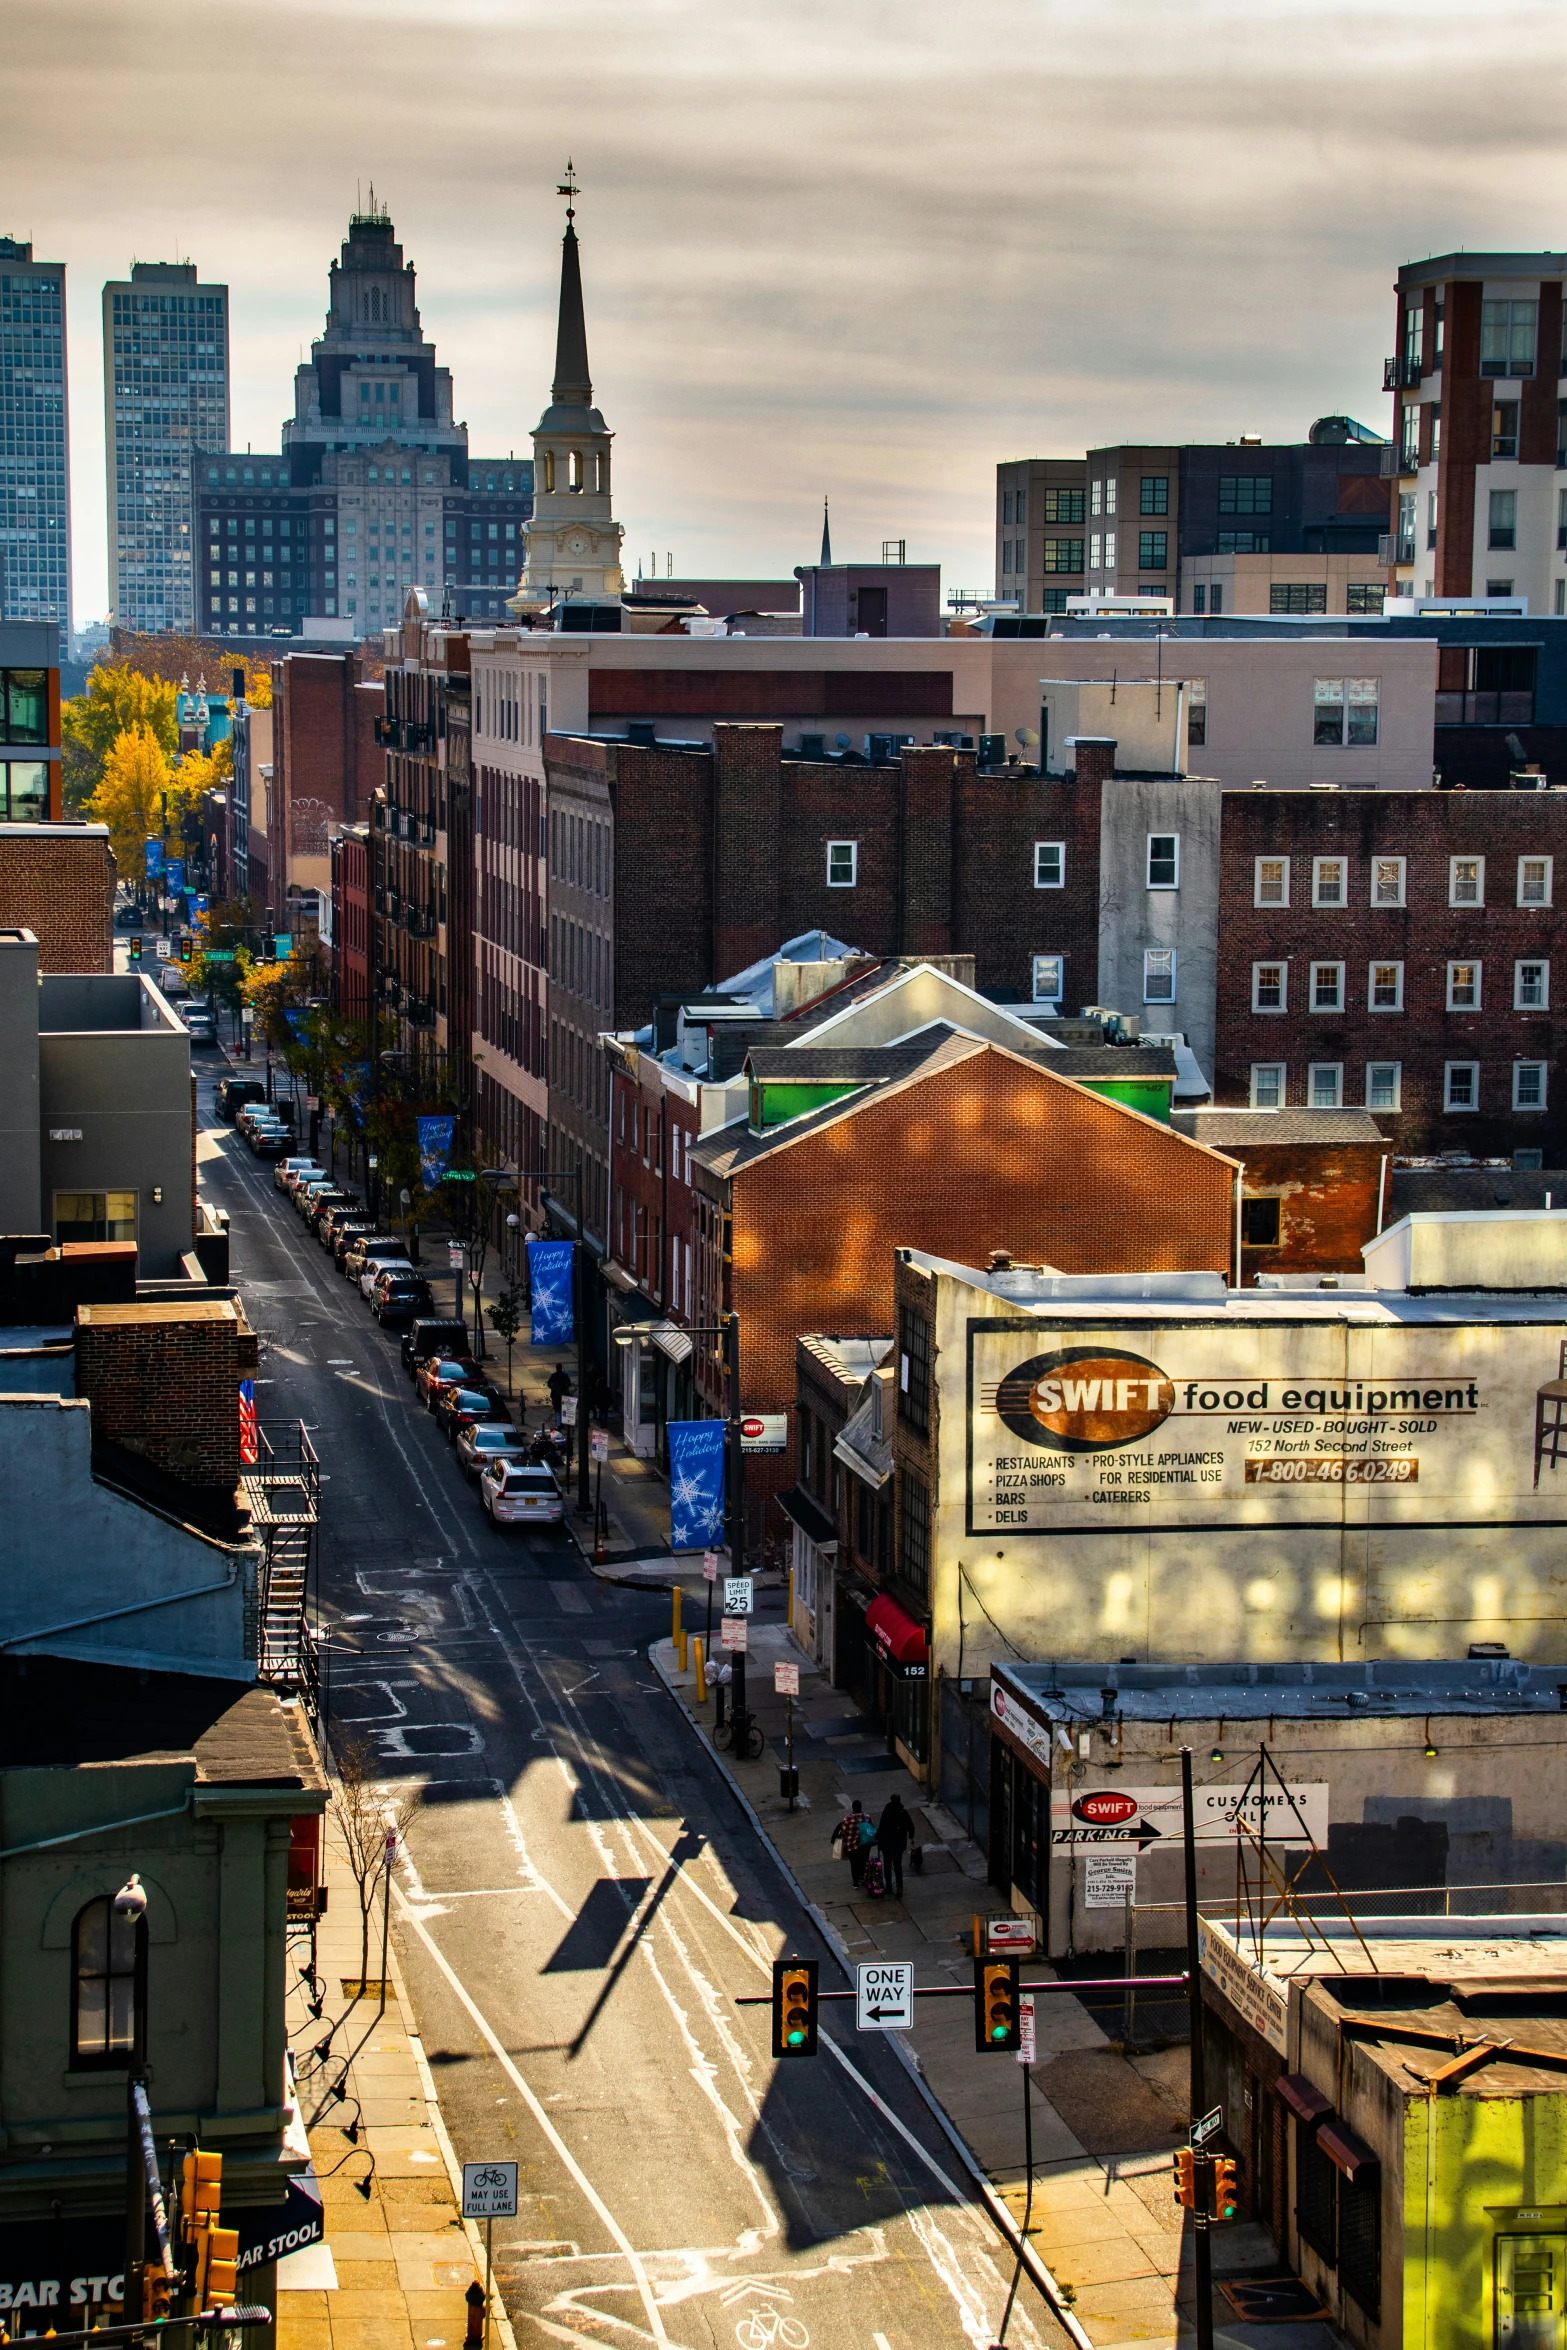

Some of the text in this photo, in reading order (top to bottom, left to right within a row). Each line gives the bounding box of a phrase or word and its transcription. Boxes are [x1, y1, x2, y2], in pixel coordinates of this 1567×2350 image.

[210, 833, 219, 893] Arden
[533, 1249, 565, 1263] Happy
[531, 1258, 572, 1275] Holidays
[1036, 1378, 1167, 1414] SWIFT
[1183, 1382, 1268, 1410] food
[1281, 1382, 1479, 1415] equipment
[1227, 1421, 1262, 1434] NEW
[1272, 1421, 1314, 1433] USED
[1323, 1420, 1389, 1434] BOUGHT
[1398, 1420, 1438, 1433] SOLD
[675, 1430, 714, 1447] Happy
[673, 1441, 723, 1463] Holidays
[1248, 1439, 1413, 1453] 152 North Second Street
[995, 1455, 1075, 1470] RESTAURANTS
[1092, 1451, 1224, 1468] PRO-STYLE APPLIANCES
[995, 1473, 1066, 1487] PIZZA SHOPS
[1100, 1469, 1222, 1485] FOR RESIDENTIAL USE
[995, 1492, 1026, 1506] BARS
[1092, 1490, 1151, 1504] CATERERS
[995, 1510, 1028, 1523] DELIS
[727, 1581, 750, 1589] SPEED
[729, 1588, 748, 1596] LIMIT
[729, 1596, 748, 1610] 25
[904, 1666, 925, 1676] 152
[1206, 1794, 1307, 1808] CUSTOMERS
[1087, 1802, 1134, 1815] SWIFT
[1052, 1829, 1131, 1843] PARKING
[1088, 1867, 1133, 1877] George Smith
[1087, 1884, 1134, 1892] 215-729-910
[286, 1912, 316, 1920] STOOL
[866, 1969, 905, 1984] ONE
[1210, 1933, 1223, 1958] FOOD
[1223, 1947, 1247, 1983] EQUIPMENT
[1246, 1973, 1265, 2003] SERVICE
[1266, 1993, 1282, 2022] CENTER
[866, 1986, 905, 2002] WAY
[1201, 2122, 1209, 2136] ONE
[1209, 2116, 1219, 2129] WAY
[471, 2189, 509, 2200] MAY USE
[466, 2201, 513, 2212] FULL LANE
[233, 2220, 321, 2271] BAR STOOL
[0, 2280, 60, 2309] BAR
